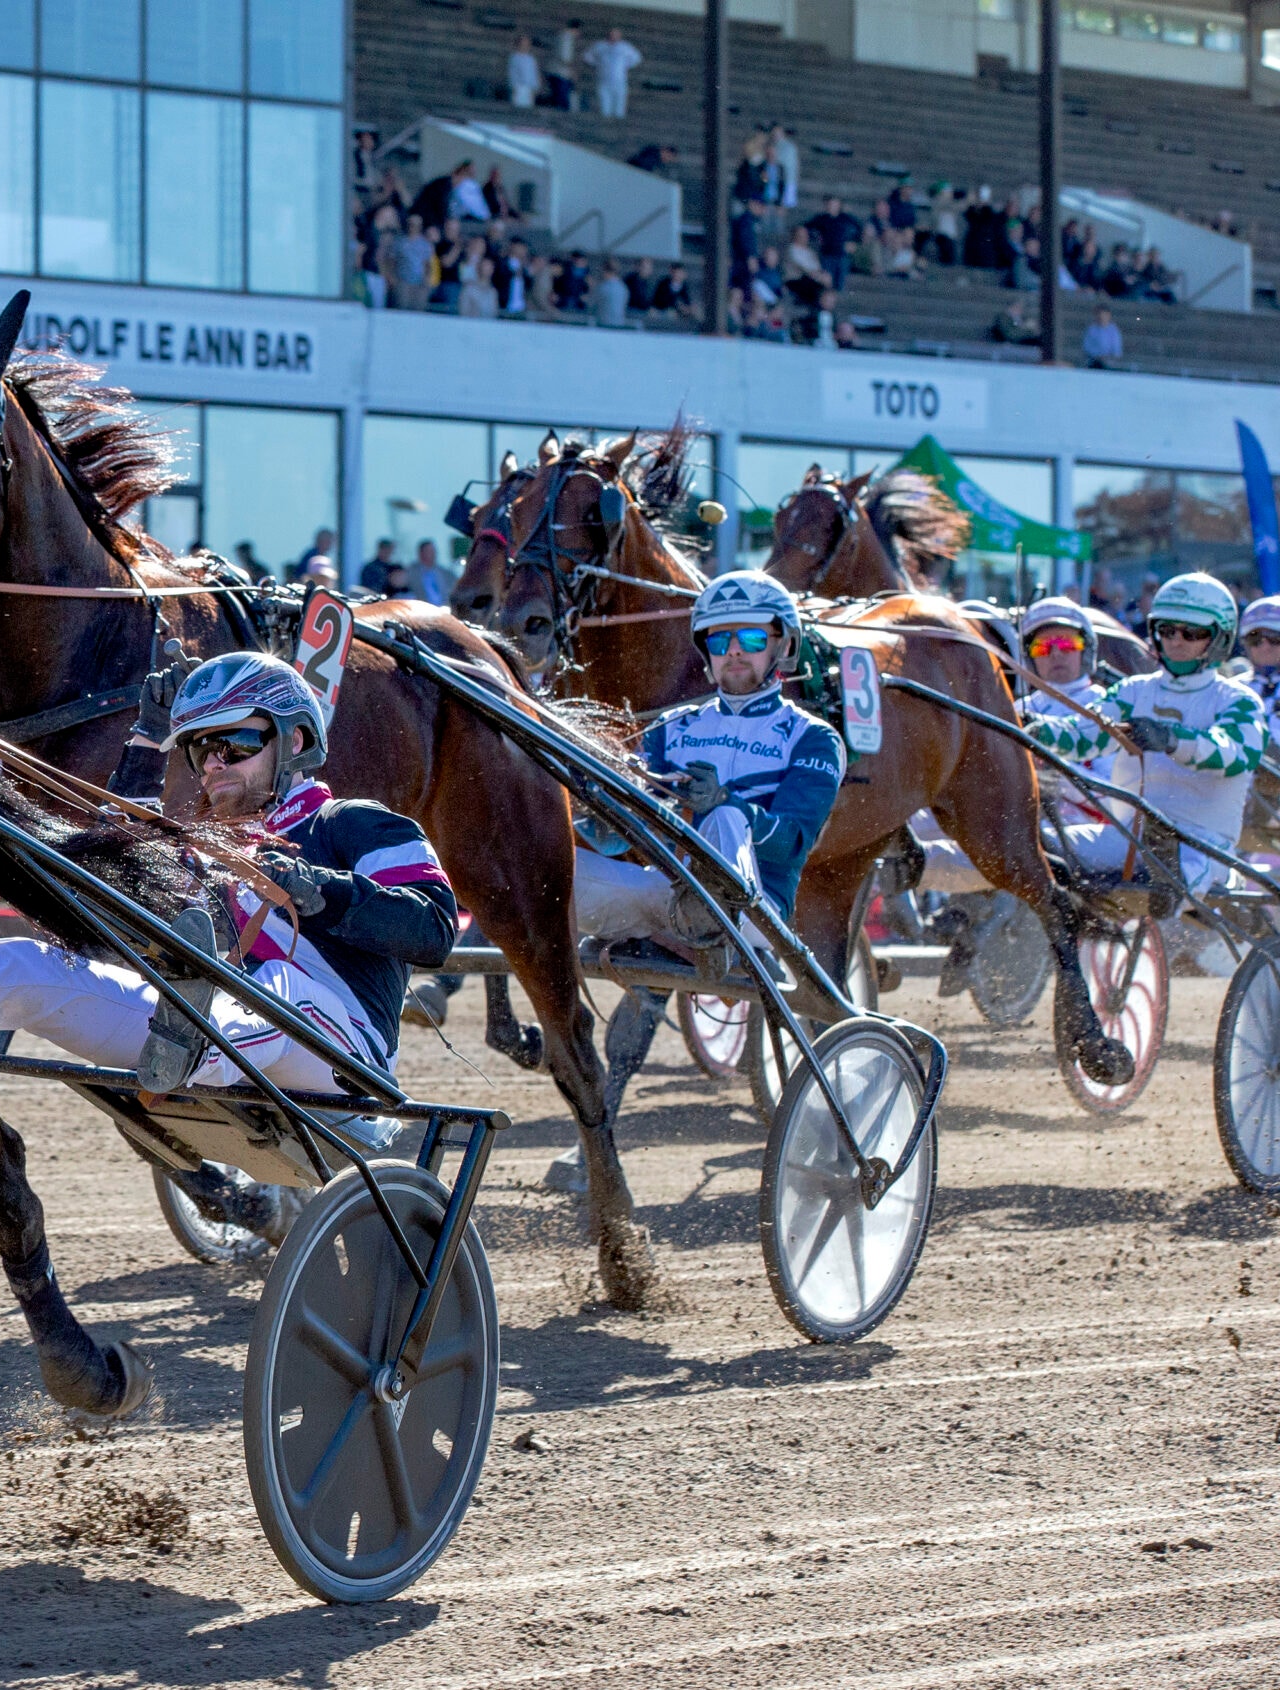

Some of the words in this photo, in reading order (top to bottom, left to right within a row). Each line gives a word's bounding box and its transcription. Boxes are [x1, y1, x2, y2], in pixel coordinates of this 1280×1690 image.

[23, 313, 127, 356] UDOLF
[137, 321, 176, 361] LE
[183, 324, 246, 368] ANN
[255, 329, 312, 372] BAR
[872, 380, 939, 418] TOTO
[303, 604, 342, 693] 2
[850, 653, 874, 719] 3
